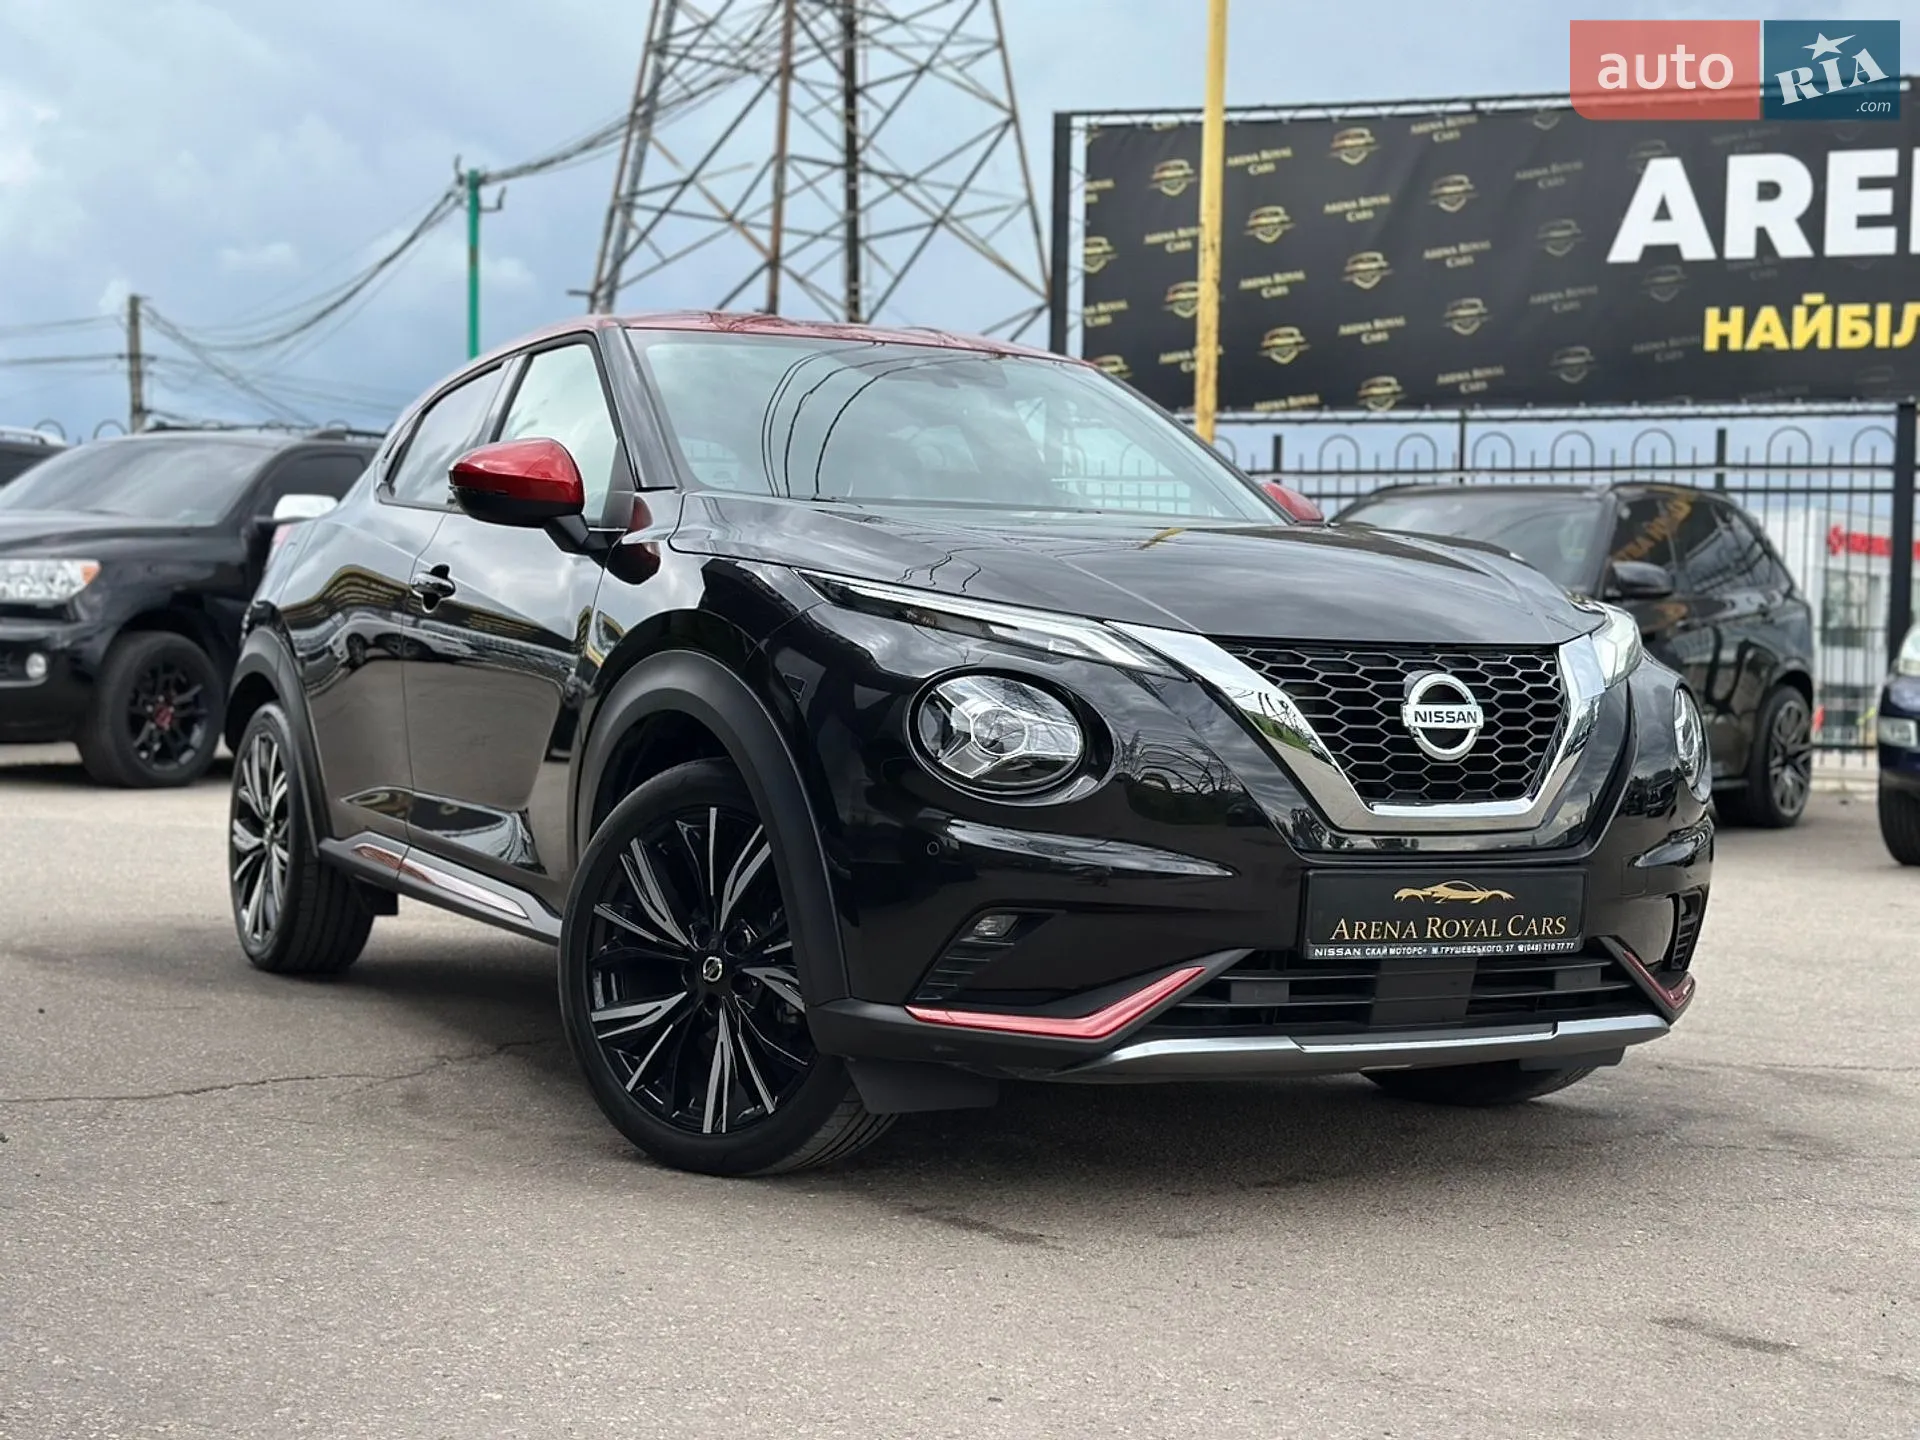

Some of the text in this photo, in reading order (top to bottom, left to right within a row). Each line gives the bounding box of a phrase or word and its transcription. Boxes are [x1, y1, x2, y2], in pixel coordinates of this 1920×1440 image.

[1606, 147, 1920, 263] ARE
[1414, 711, 1477, 723] NISSAN
[1330, 914, 1567, 940] ARENA ROYAL CARS
[1314, 947, 1361, 957] NISSAN
